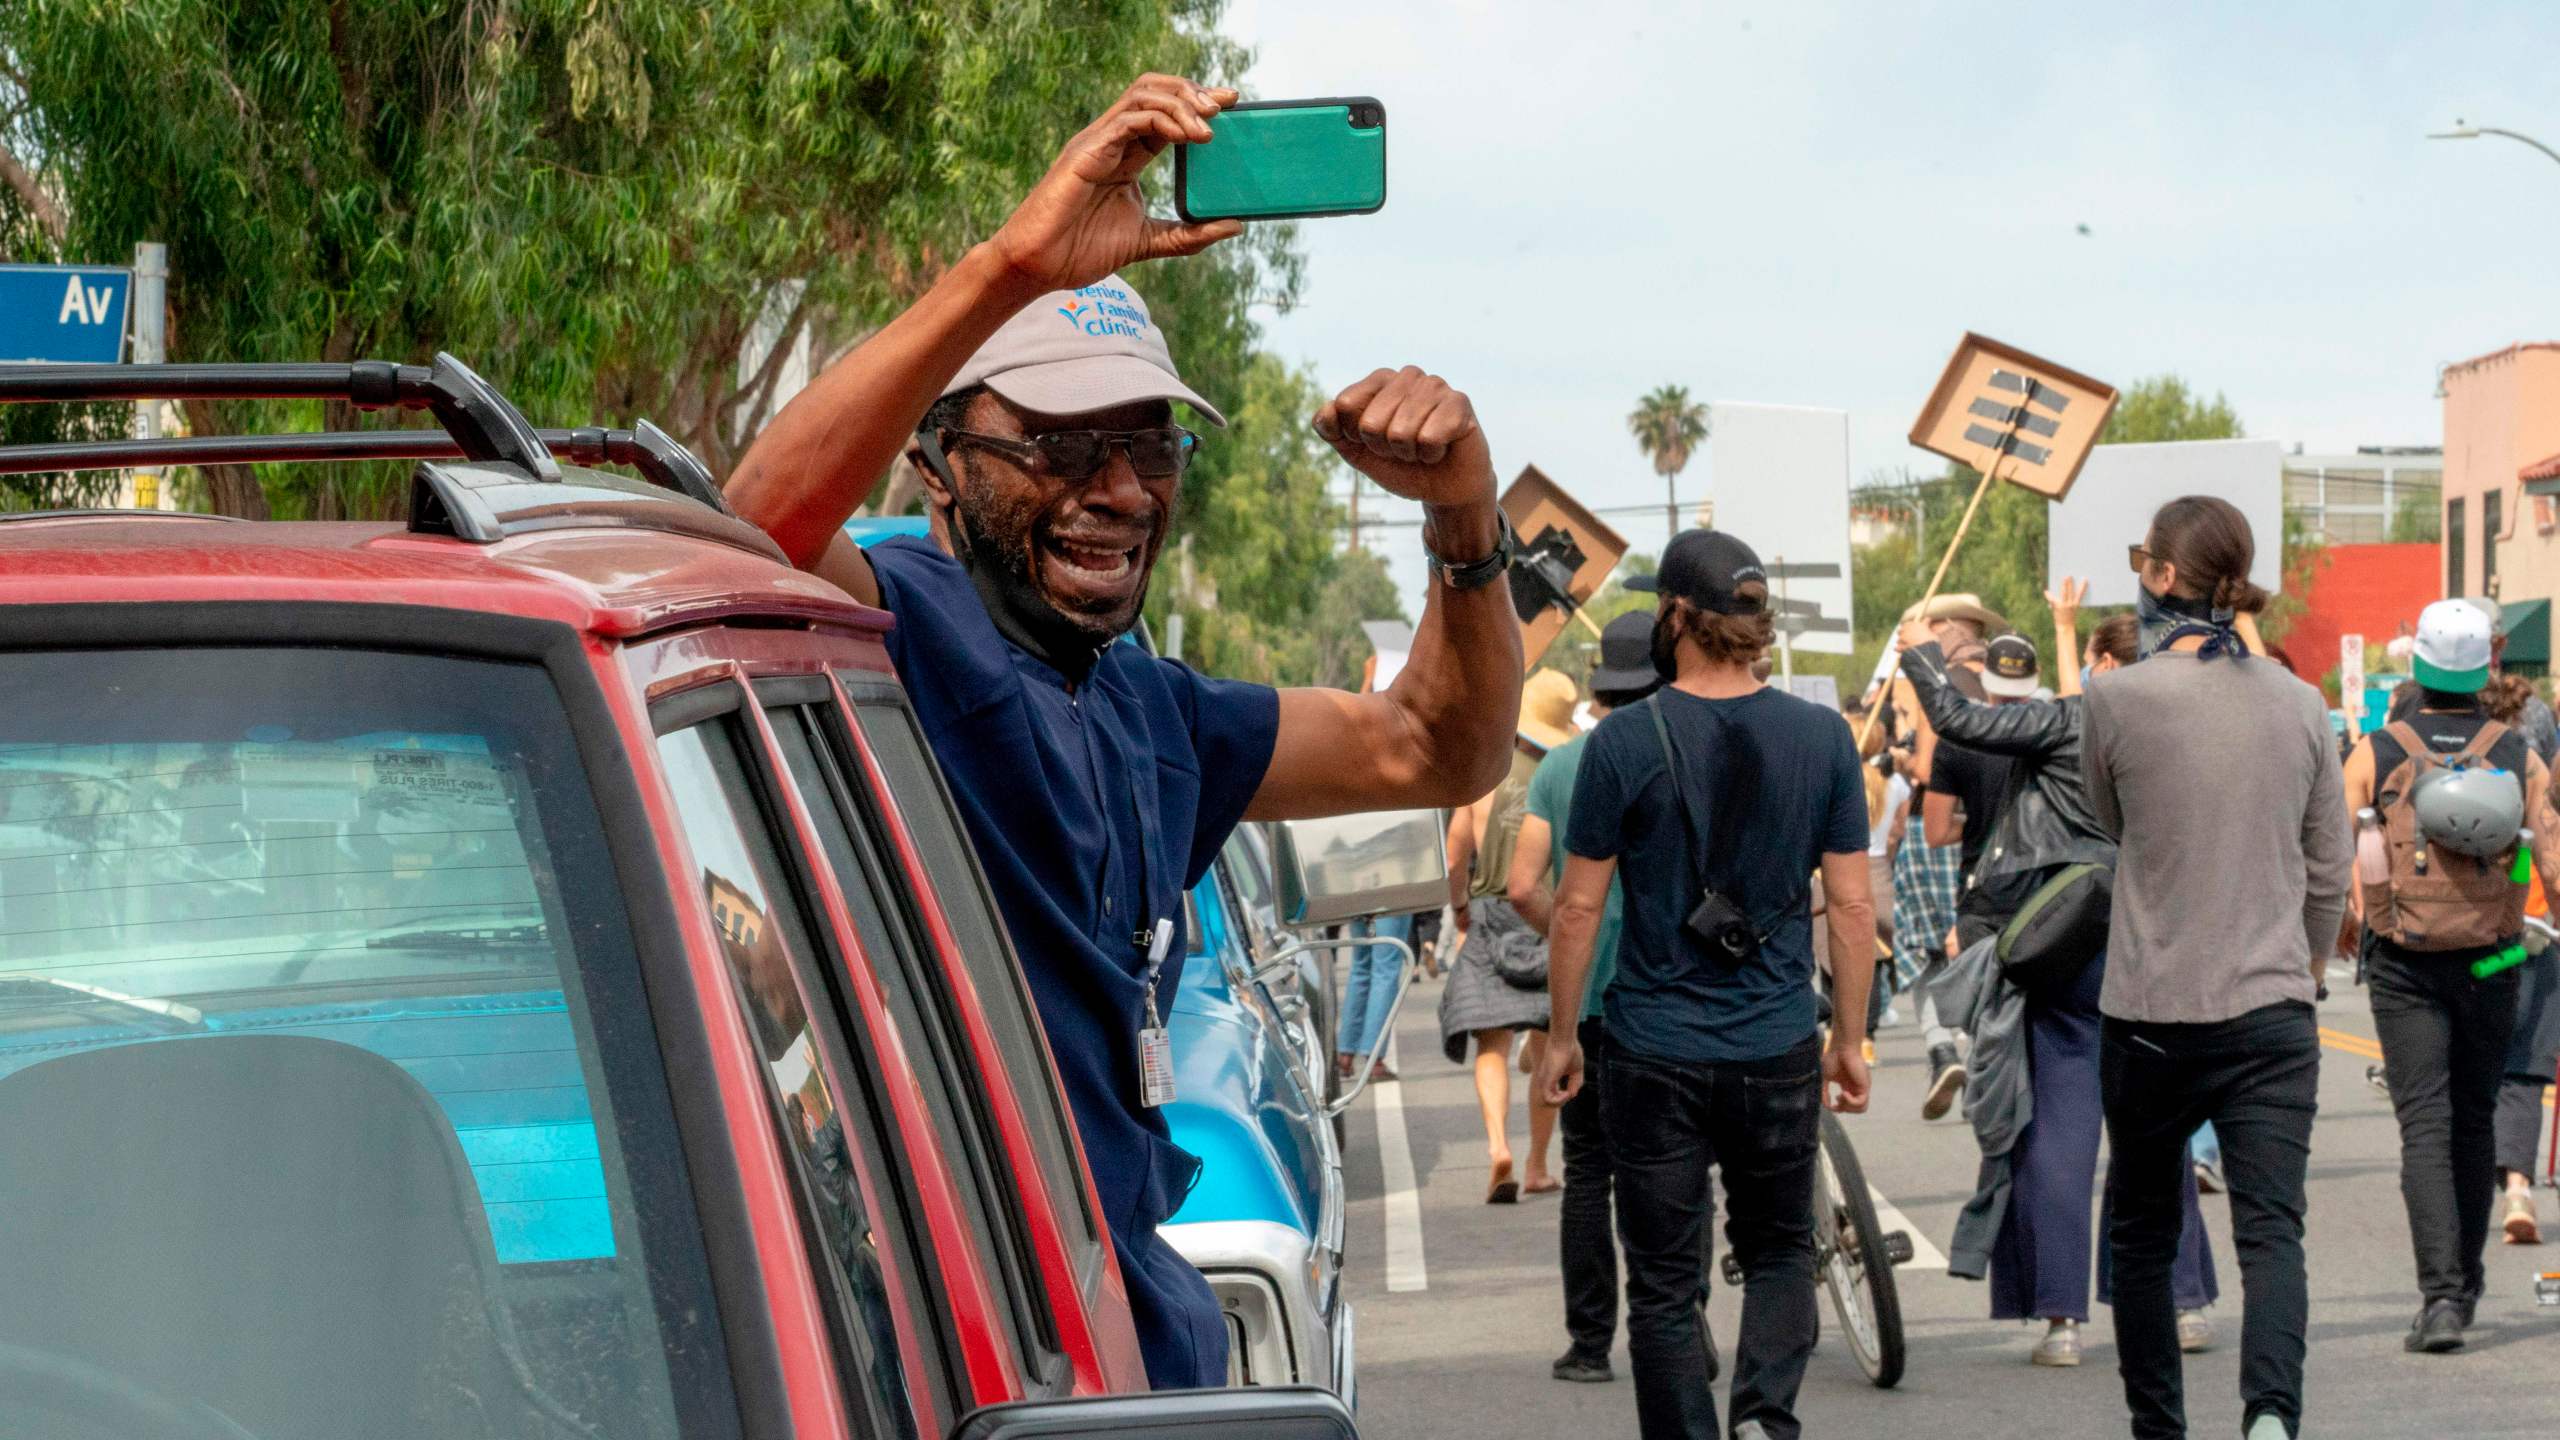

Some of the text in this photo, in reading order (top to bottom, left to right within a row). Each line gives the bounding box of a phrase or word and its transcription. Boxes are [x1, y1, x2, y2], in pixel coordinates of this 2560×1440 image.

[59, 275, 113, 324] Av
[1096, 300, 1147, 329] Family
[1085, 319, 1142, 340] Clinic
